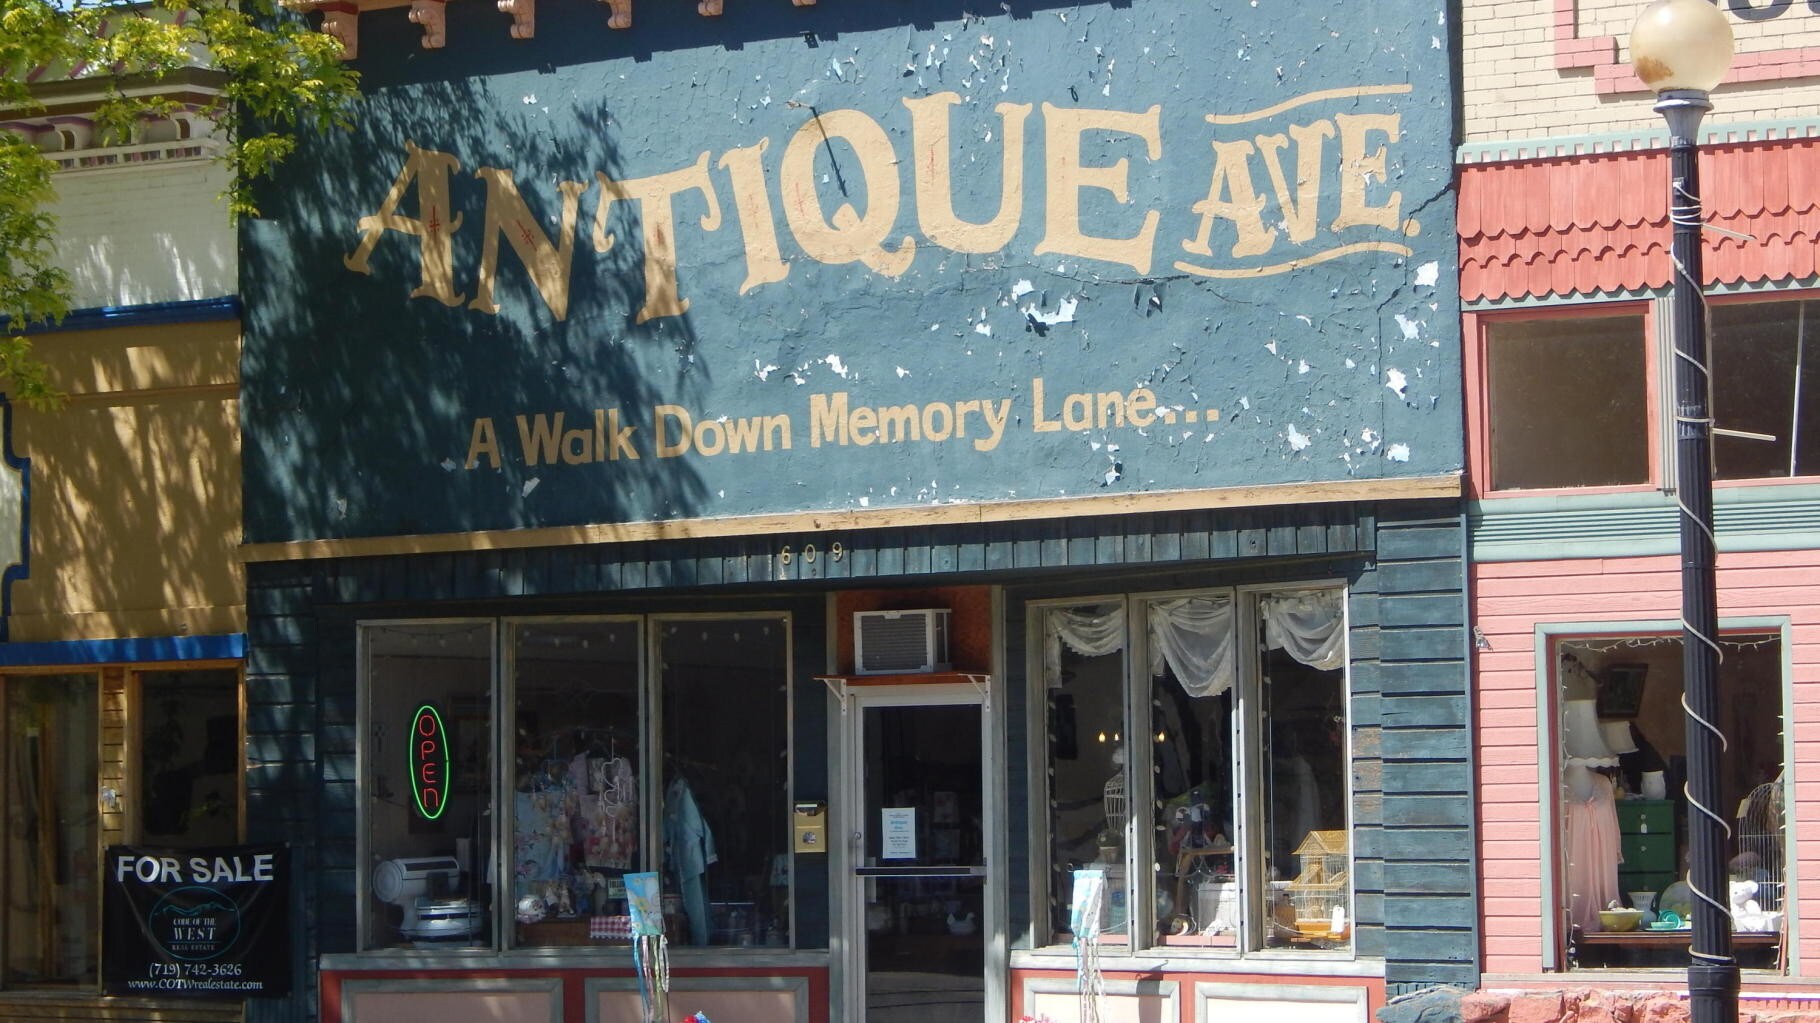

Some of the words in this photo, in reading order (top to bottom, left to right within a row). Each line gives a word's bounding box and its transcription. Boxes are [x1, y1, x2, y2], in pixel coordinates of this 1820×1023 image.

[343, 90, 1163, 323] ANTIQUE
[464, 417, 501, 470] A
[516, 408, 640, 467] Walk
[654, 404, 792, 459] Down
[810, 391, 1011, 452] Memory
[781, 541, 843, 565] 609
[117, 856, 183, 883] FOR
[189, 854, 274, 883] SALE
[173, 927, 217, 941] WEST
[149, 963, 181, 978] (719)
[184, 963, 242, 976] 742-3626
[128, 977, 263, 990] www.COTWrealestate.com
